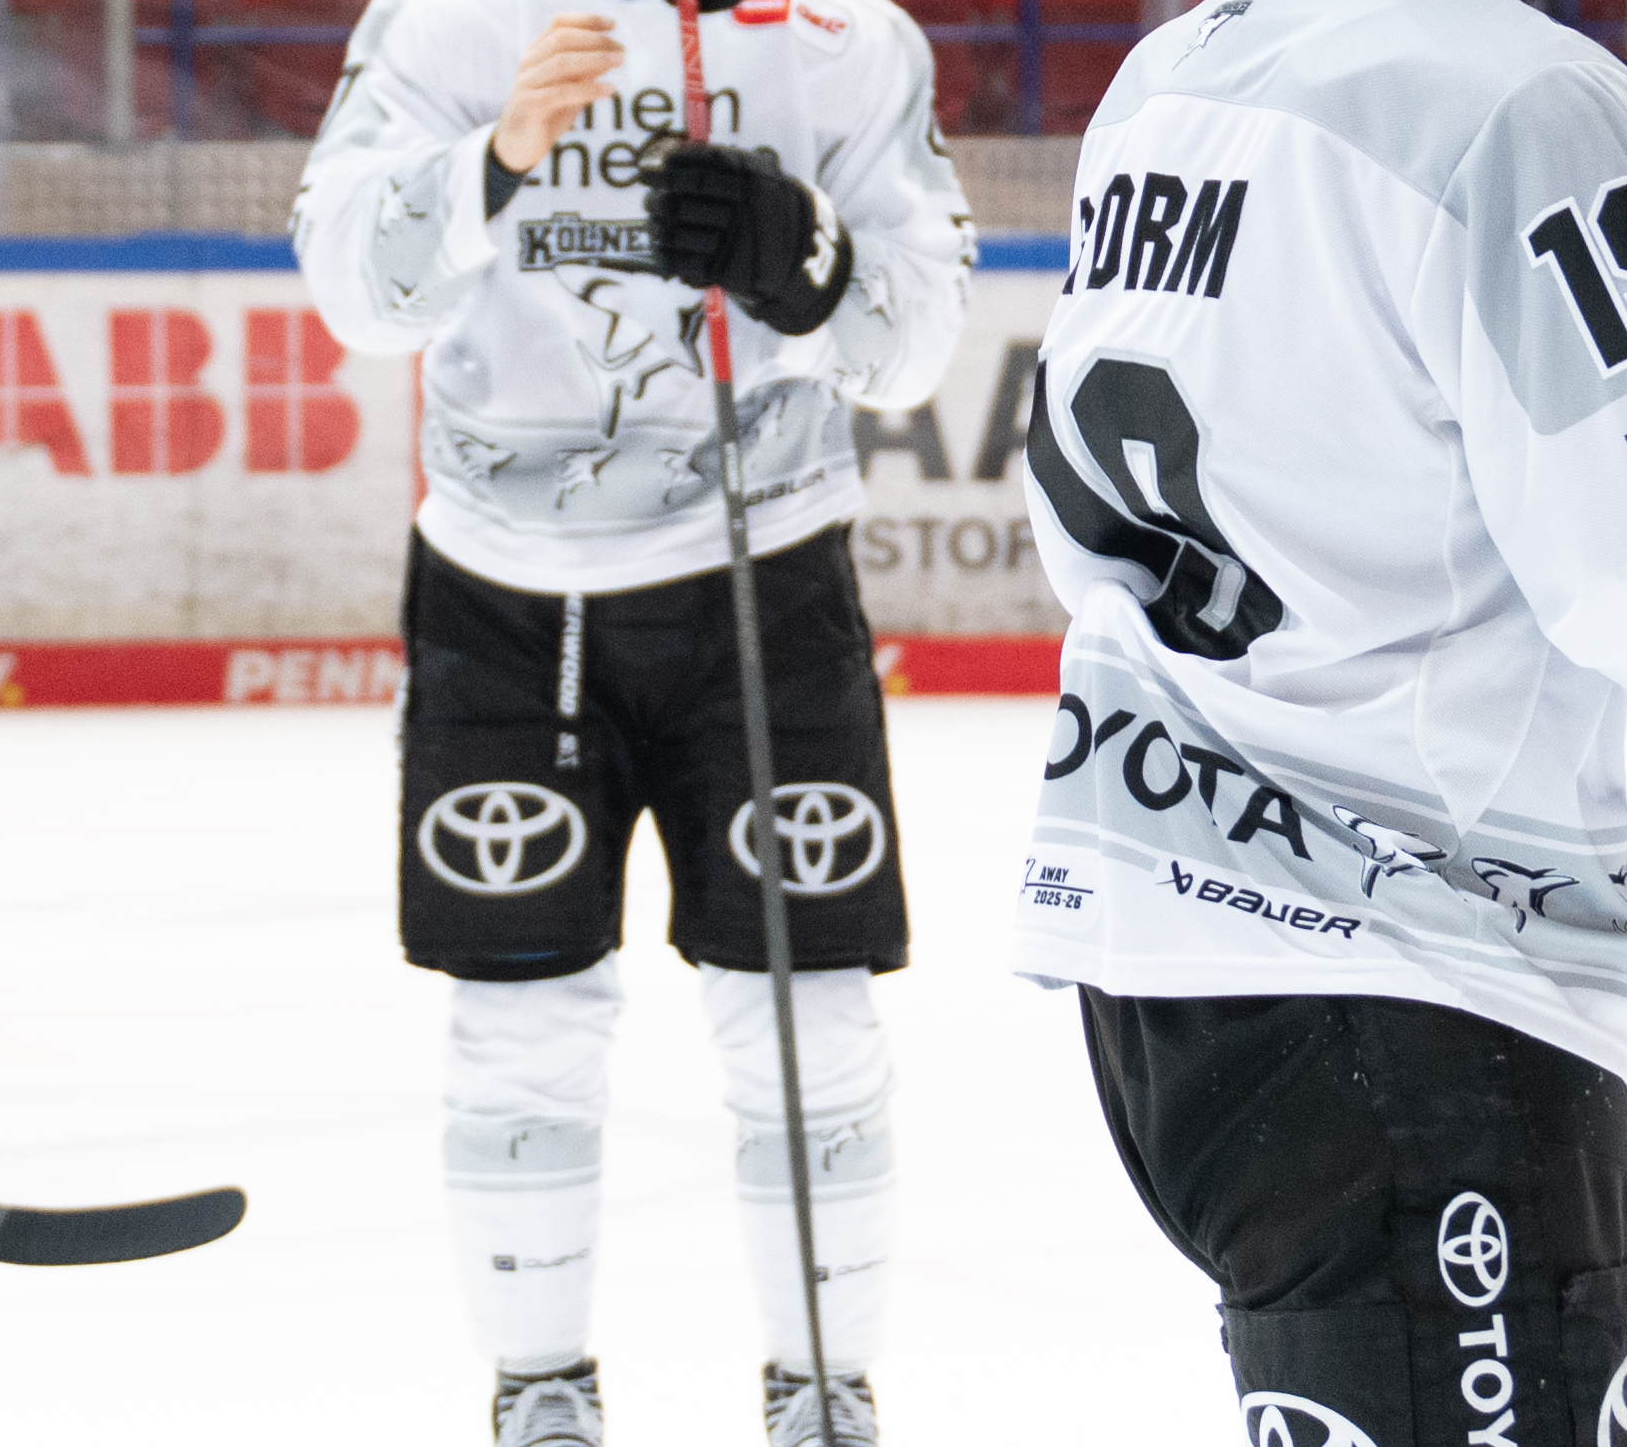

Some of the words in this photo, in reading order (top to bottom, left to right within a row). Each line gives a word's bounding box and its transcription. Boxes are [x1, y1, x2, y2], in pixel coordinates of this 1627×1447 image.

[1063, 171, 1250, 300] ORM
[225, 649, 408, 706] PENN
[1044, 692, 1315, 863] OYOTA
[1033, 889, 1083, 910] 2025-26
[1038, 865, 1070, 884] AWAY
[1195, 878, 1362, 940] BAUER
